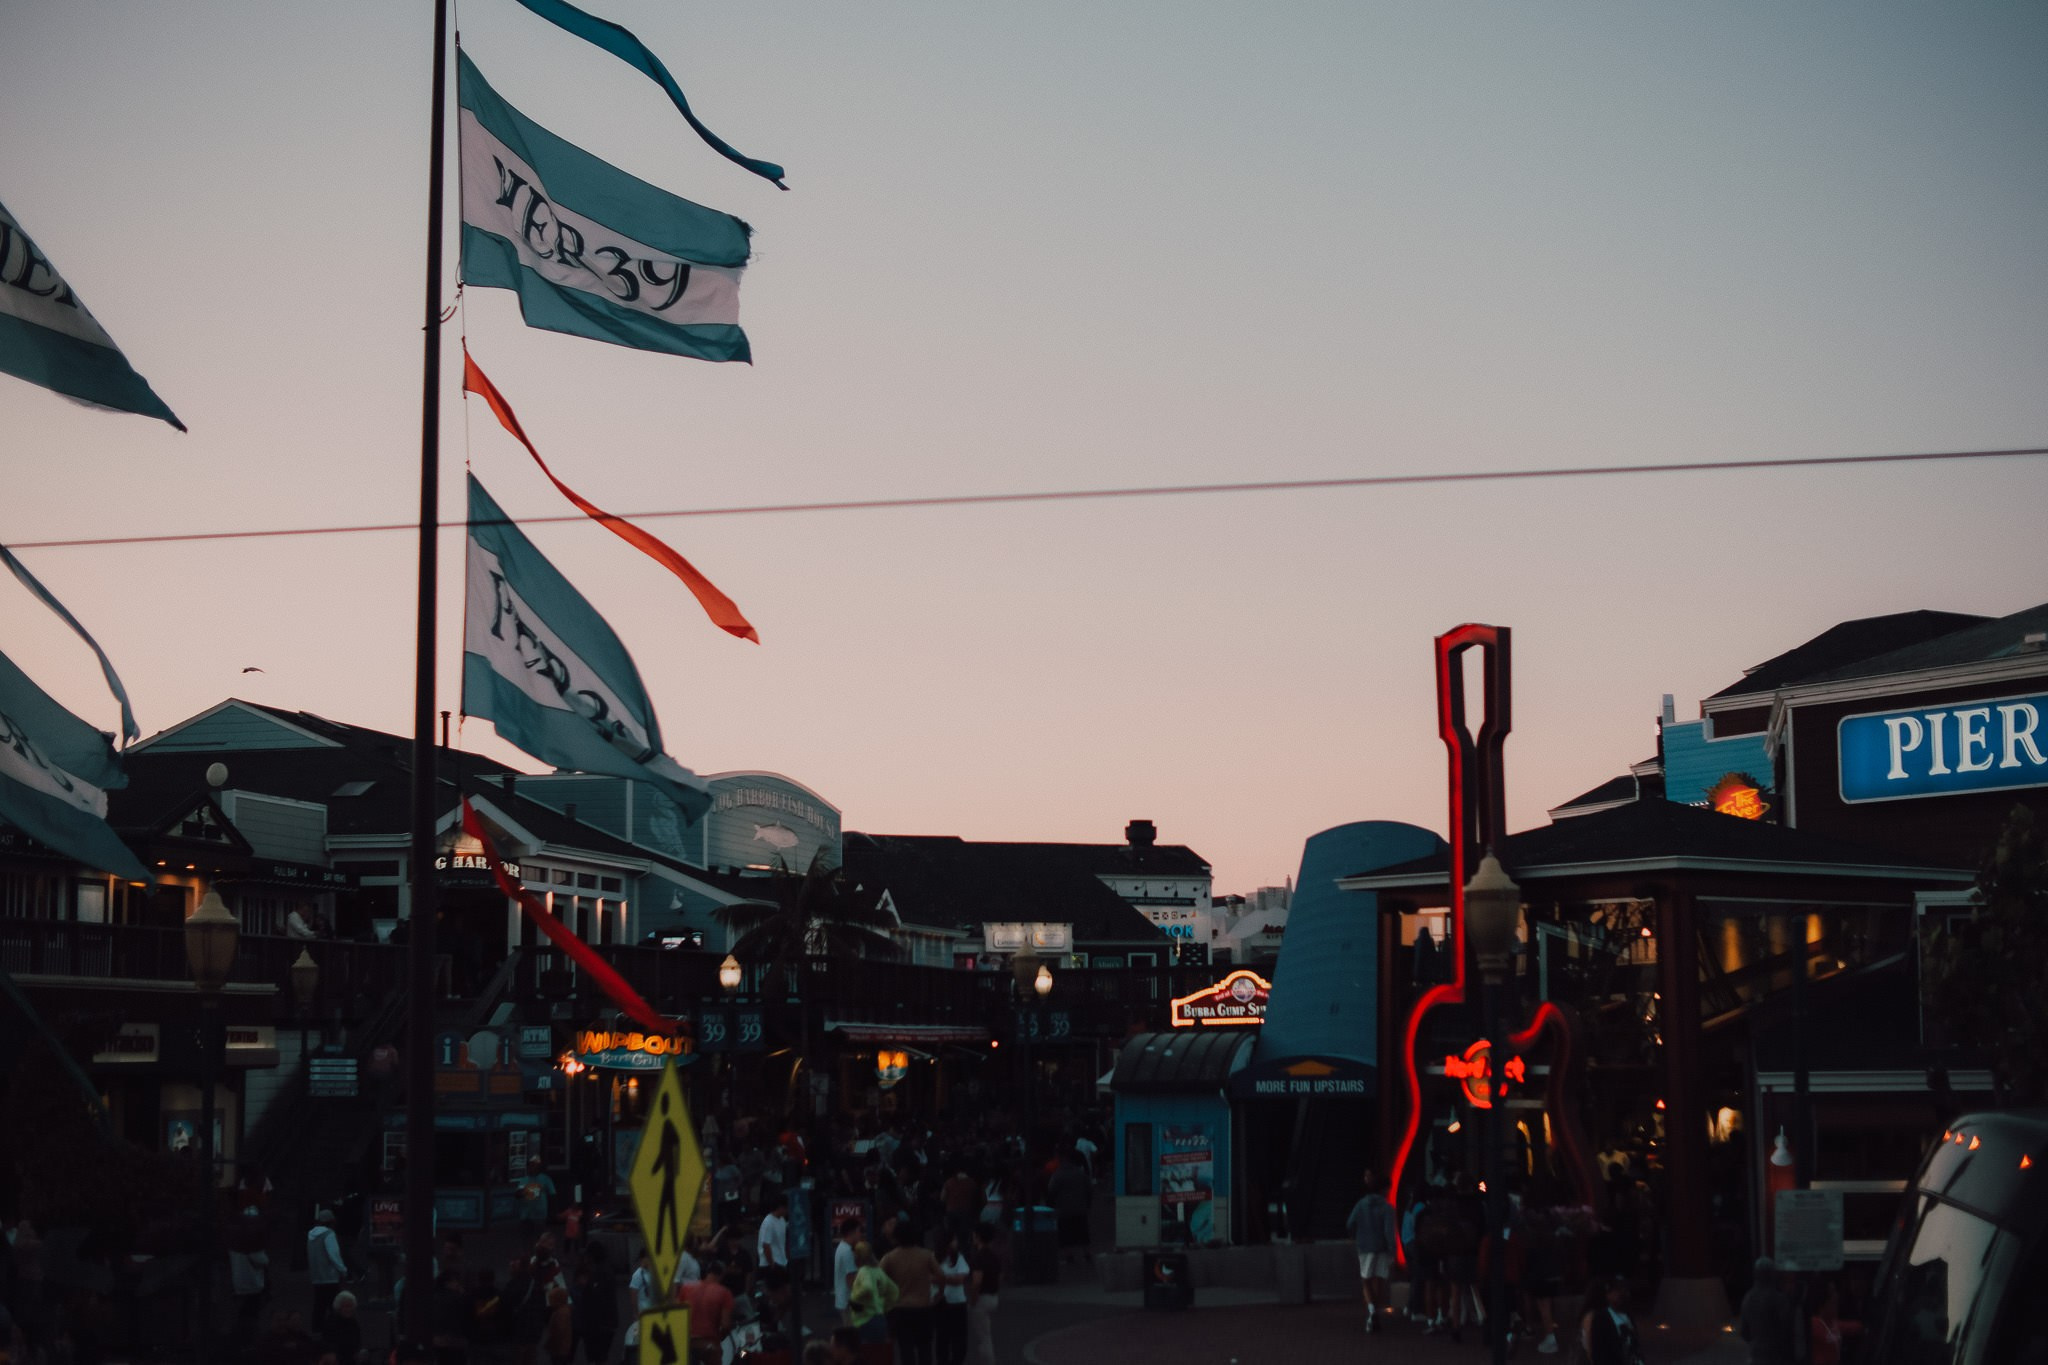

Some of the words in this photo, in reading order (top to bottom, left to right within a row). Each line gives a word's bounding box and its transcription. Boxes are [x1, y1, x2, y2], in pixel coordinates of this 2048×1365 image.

[1884, 703, 2047, 780] PIER
[1183, 1003, 1216, 1017] BUBBA
[1217, 1002, 1246, 1017] GUMP
[704, 1023, 726, 1042] 39
[739, 1023, 761, 1042] 39
[1050, 1020, 1070, 1037] 39
[1256, 1080, 1286, 1093] MORE
[1289, 1080, 1310, 1093] FUN
[1314, 1080, 1365, 1093] UPSTAIRS
